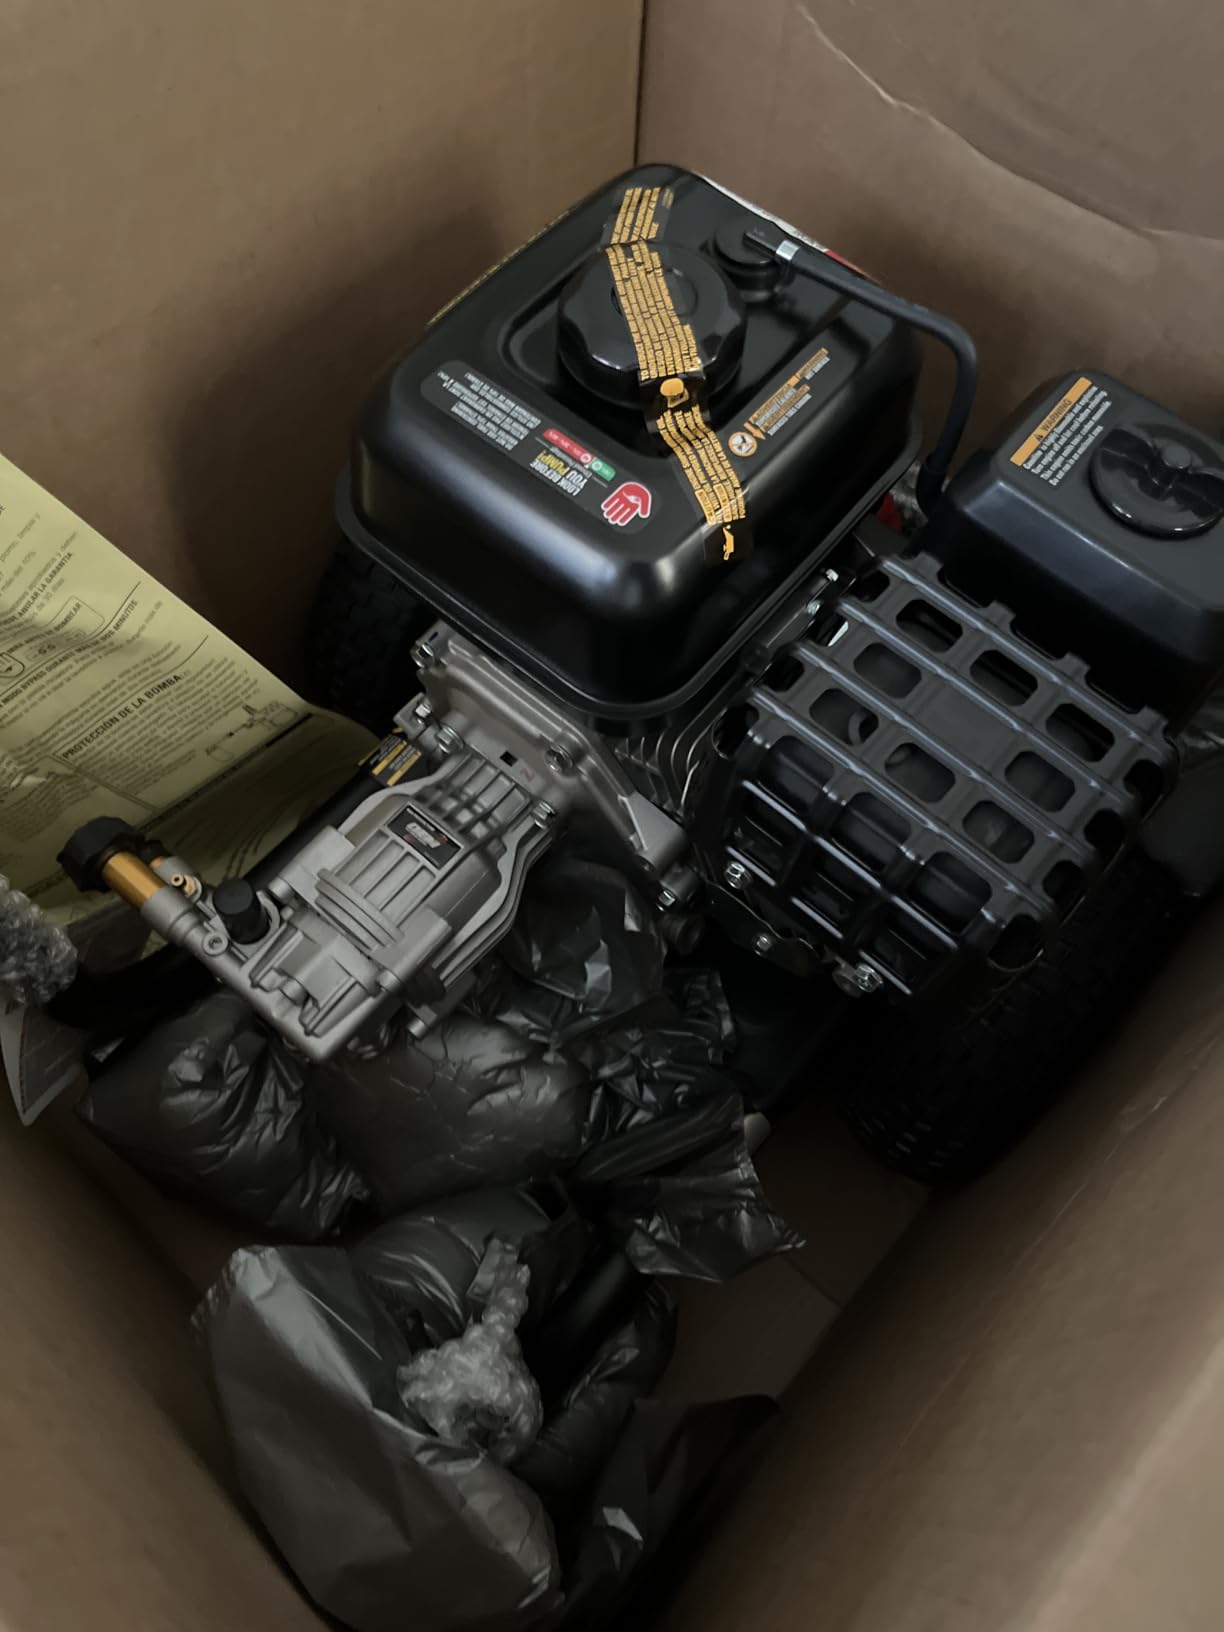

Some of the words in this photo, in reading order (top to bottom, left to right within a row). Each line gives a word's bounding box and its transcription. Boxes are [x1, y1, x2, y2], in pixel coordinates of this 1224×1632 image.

[1038, 396, 1073, 433] WARNING
[528, 457, 562, 483] BEFORE
[535, 448, 570, 476] PUMP!
[556, 476, 581, 496] LOOK
[564, 468, 588, 488] YOU
[112, 598, 139, 631] MINUTOS
[60, 713, 120, 760] PROTECCIÓN
[117, 704, 135, 720] DE
[130, 694, 147, 711] LA
[143, 671, 183, 702] BOMBA
